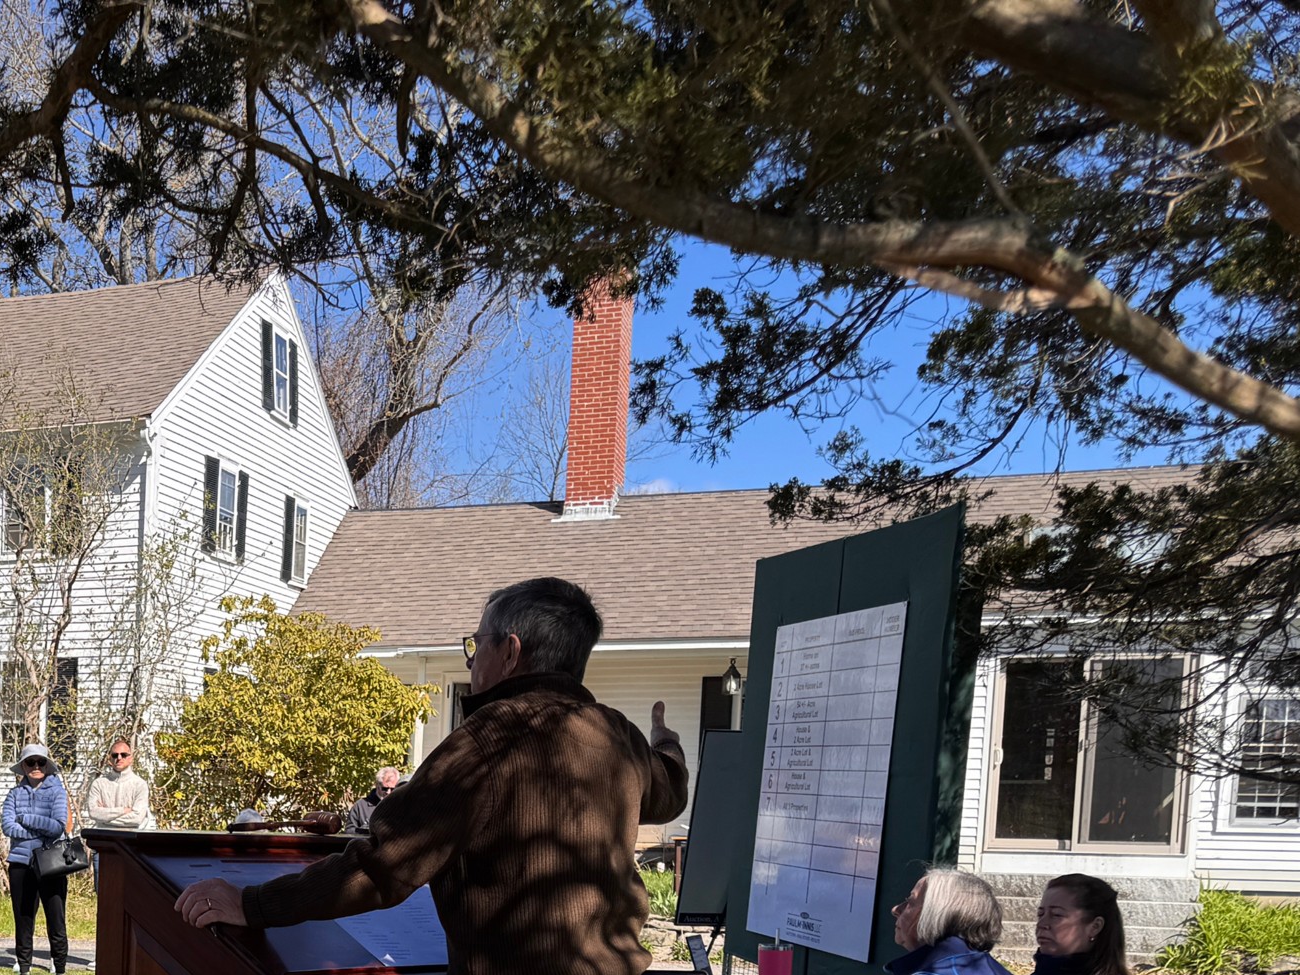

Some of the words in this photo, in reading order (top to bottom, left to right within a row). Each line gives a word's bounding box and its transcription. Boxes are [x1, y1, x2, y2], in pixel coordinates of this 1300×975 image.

[780, 658, 785, 674] 1
[777, 681, 783, 697] 2
[775, 704, 780, 720] 3
[792, 711, 812, 721] Agricultural
[772, 728, 778, 743] 4
[771, 751, 776, 766] 5
[787, 760, 807, 768] Agricultural
[768, 774, 773, 789] 6
[785, 783, 804, 791] Agricultural
[766, 797, 771, 811] 7
[791, 803, 809, 811] Properties
[787, 917, 798, 928] PAUL
